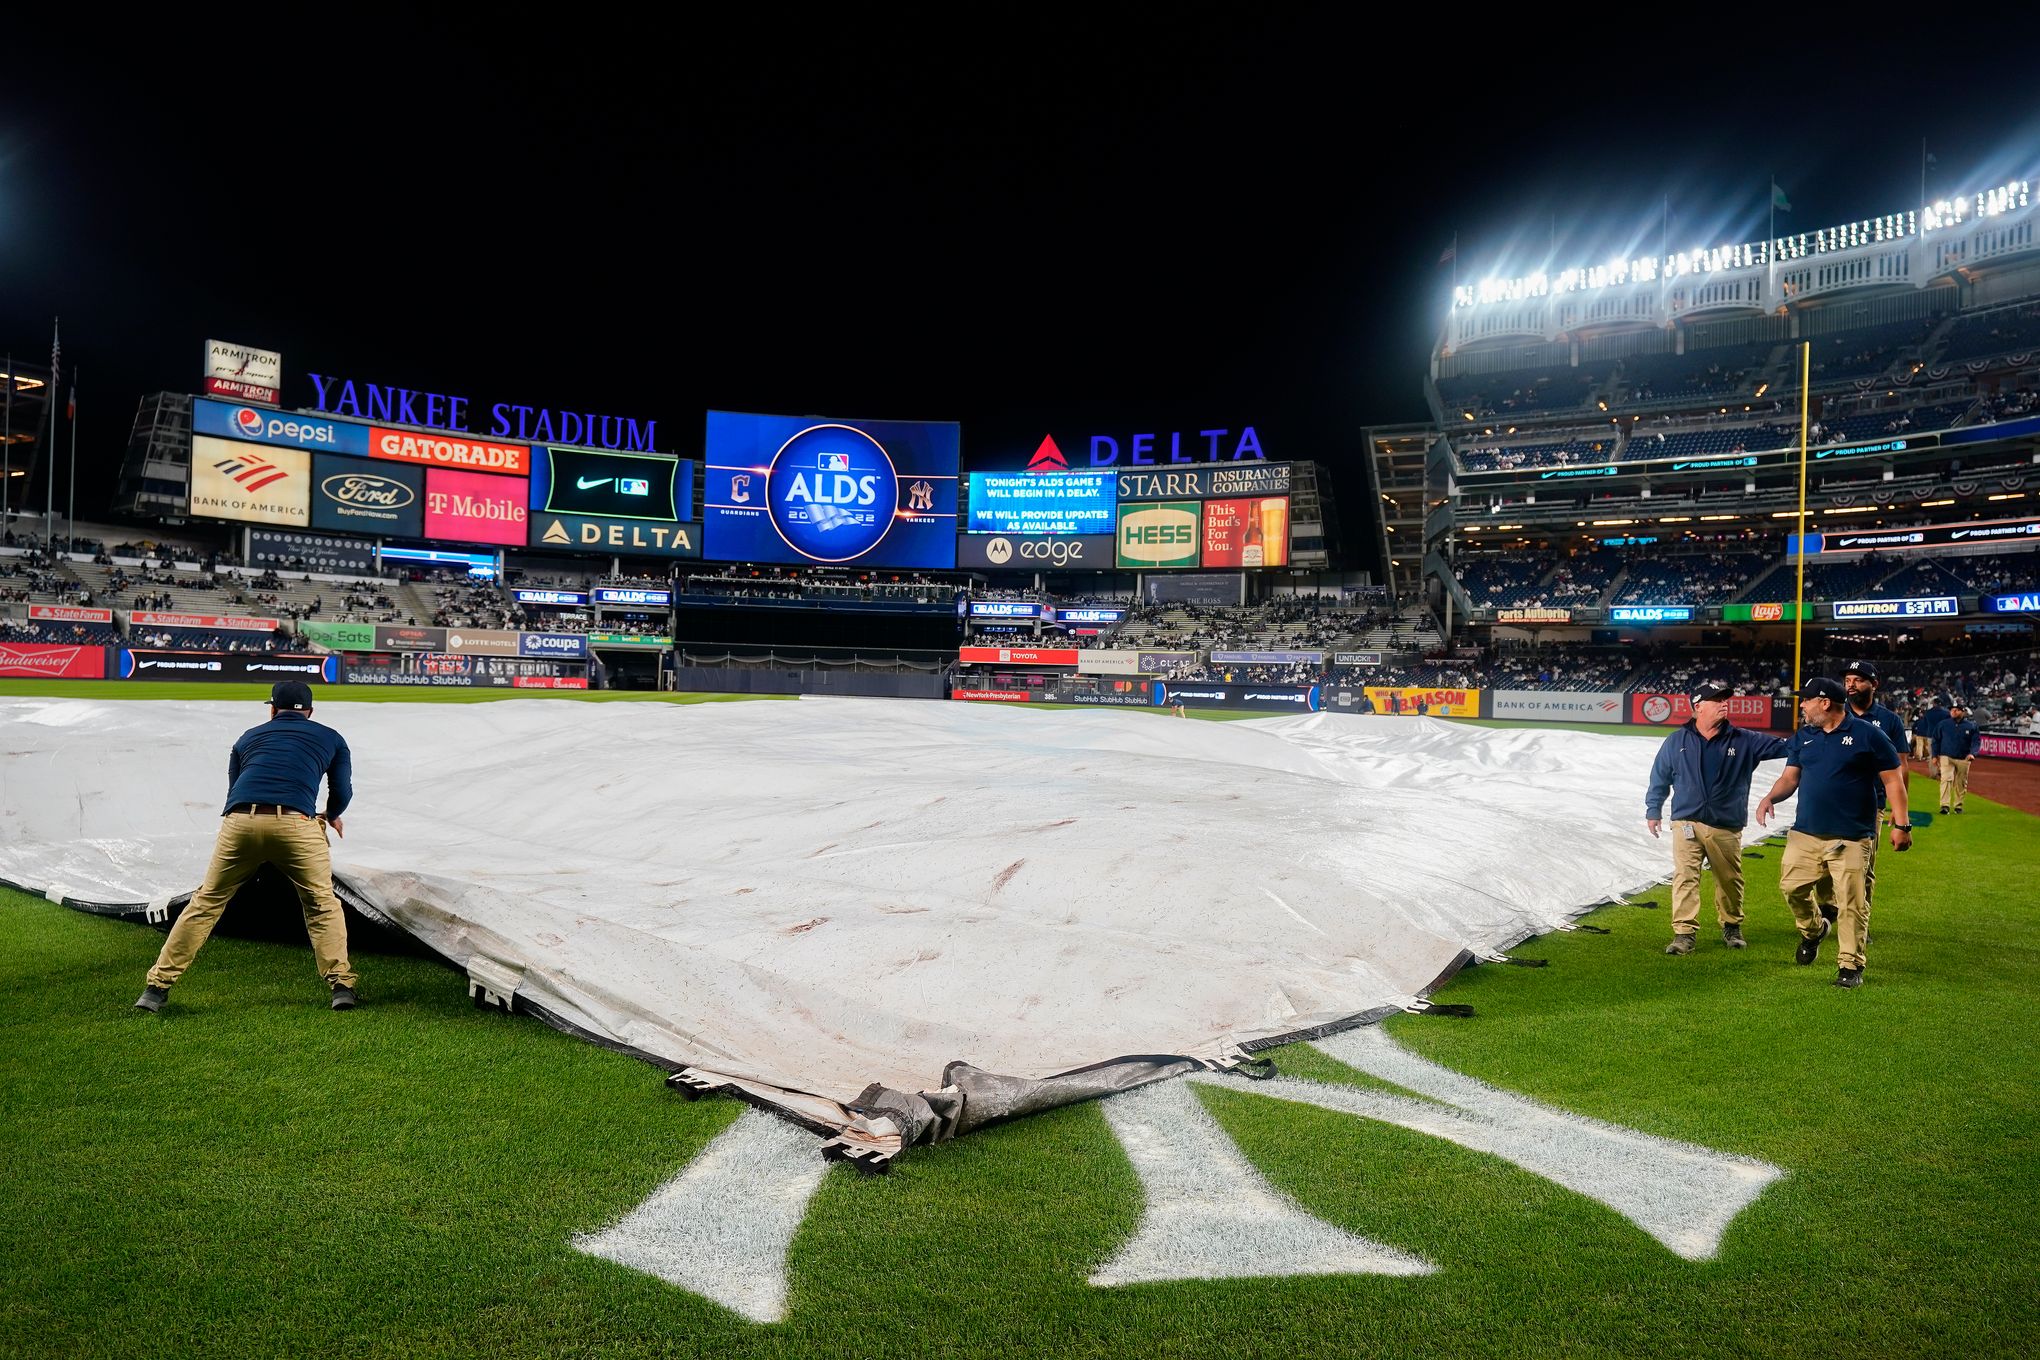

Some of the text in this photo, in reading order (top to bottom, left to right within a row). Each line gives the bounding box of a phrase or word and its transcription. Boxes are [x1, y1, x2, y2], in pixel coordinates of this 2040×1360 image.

[212, 346, 277, 366] ARMITRON
[214, 380, 272, 397] ARMITRON
[308, 373, 658, 453] YANKEE STADIUM
[268, 419, 334, 443] pepsi
[381, 435, 520, 469] GATORADE
[1090, 427, 1264, 467] DELTA
[1835, 448, 1856, 456] PROUD
[1856, 445, 1882, 454] PARTNER
[1690, 461, 1709, 469] PROUD
[1213, 467, 1290, 483] INSURANCE
[985, 477, 1102, 487] TONIGHT'S ALDS GAME 5
[1118, 473, 1203, 497] STARR
[1213, 479, 1289, 494] COMPANIES
[337, 477, 399, 505] Ford
[785, 472, 876, 506] ALDS
[987, 488, 1100, 498] WILL BEGIN IN A DELAY.
[193, 496, 305, 517] BANK OF AMERICA
[452, 495, 526, 522] Mobile
[1208, 504, 1236, 516] This
[337, 506, 398, 520] BuyFordNow.com
[720, 509, 760, 517] GUARDIANS
[977, 510, 1108, 519] WE WILL PROVIDE UPDATES
[1007, 521, 1077, 530] AS AVAILABLE.
[1208, 517, 1241, 528] Bud's
[582, 523, 692, 550] DELTA
[1126, 525, 1192, 545] HESS
[1208, 529, 1229, 540] For
[1020, 536, 1083, 567] edge
[1208, 540, 1233, 551] You.
[533, 592, 559, 603] ALDS
[617, 592, 647, 602] ALDS
[54, 608, 104, 620] State Farm
[986, 604, 1013, 615] ALDS
[1498, 608, 1571, 619] Parts Authority
[1754, 605, 1782, 619] Lay's
[1838, 601, 1949, 615] ARMITRON 6:37 PM
[157, 615, 201, 625] State Farm
[1077, 611, 1100, 621] ALDS
[1631, 609, 1663, 620] ALDS
[227, 619, 269, 628] State Farm
[337, 631, 372, 644] Eats
[542, 637, 580, 651] coupa
[0, 652, 69, 667] Budweiser
[348, 673, 387, 684] StubHub
[390, 673, 429, 685] StubHub
[432, 674, 471, 685] StubHub
[1074, 695, 1099, 703] StubHub
[1100, 696, 1123, 704] StubHub
[1124, 696, 1148, 705] StubHub
[1528, 702, 1542, 710] OF
[1544, 703, 1594, 712] AMERICA
[1729, 699, 1764, 715] EBB
[1999, 740, 2006, 752] IN
